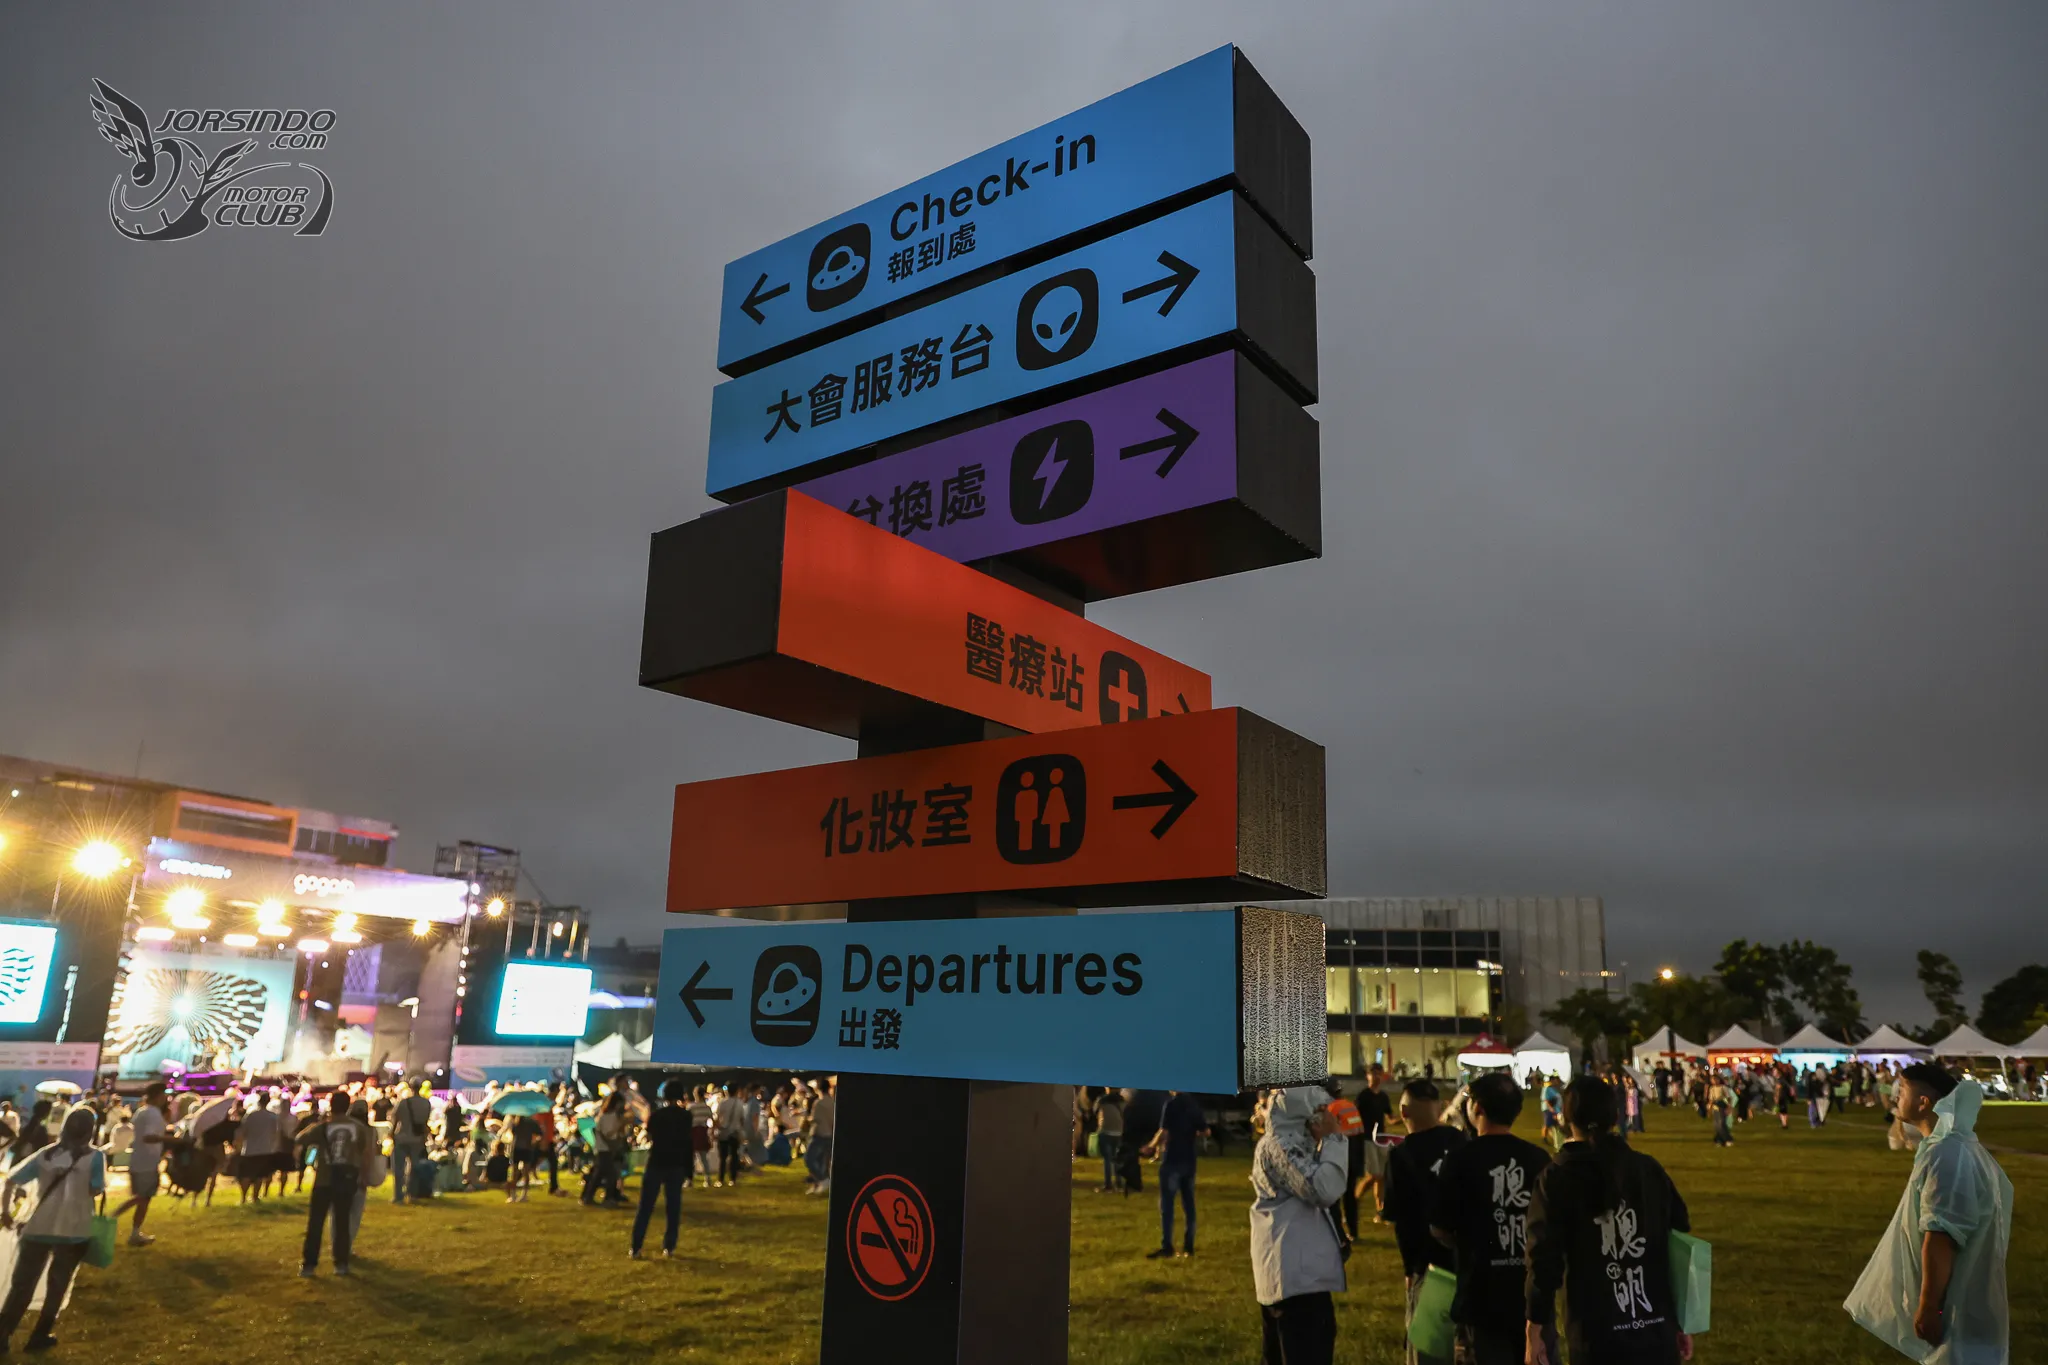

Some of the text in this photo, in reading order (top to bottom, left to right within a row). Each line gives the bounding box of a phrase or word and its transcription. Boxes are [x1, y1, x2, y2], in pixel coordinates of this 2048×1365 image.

[890, 134, 1096, 241] Check-in
[887, 221, 976, 283] 報到處
[763, 323, 994, 444] 大會服務台
[965, 612, 1085, 712] 醫療站
[820, 782, 973, 858] 化妝室
[842, 944, 1143, 1006] Departures
[838, 1007, 902, 1050] 出發
